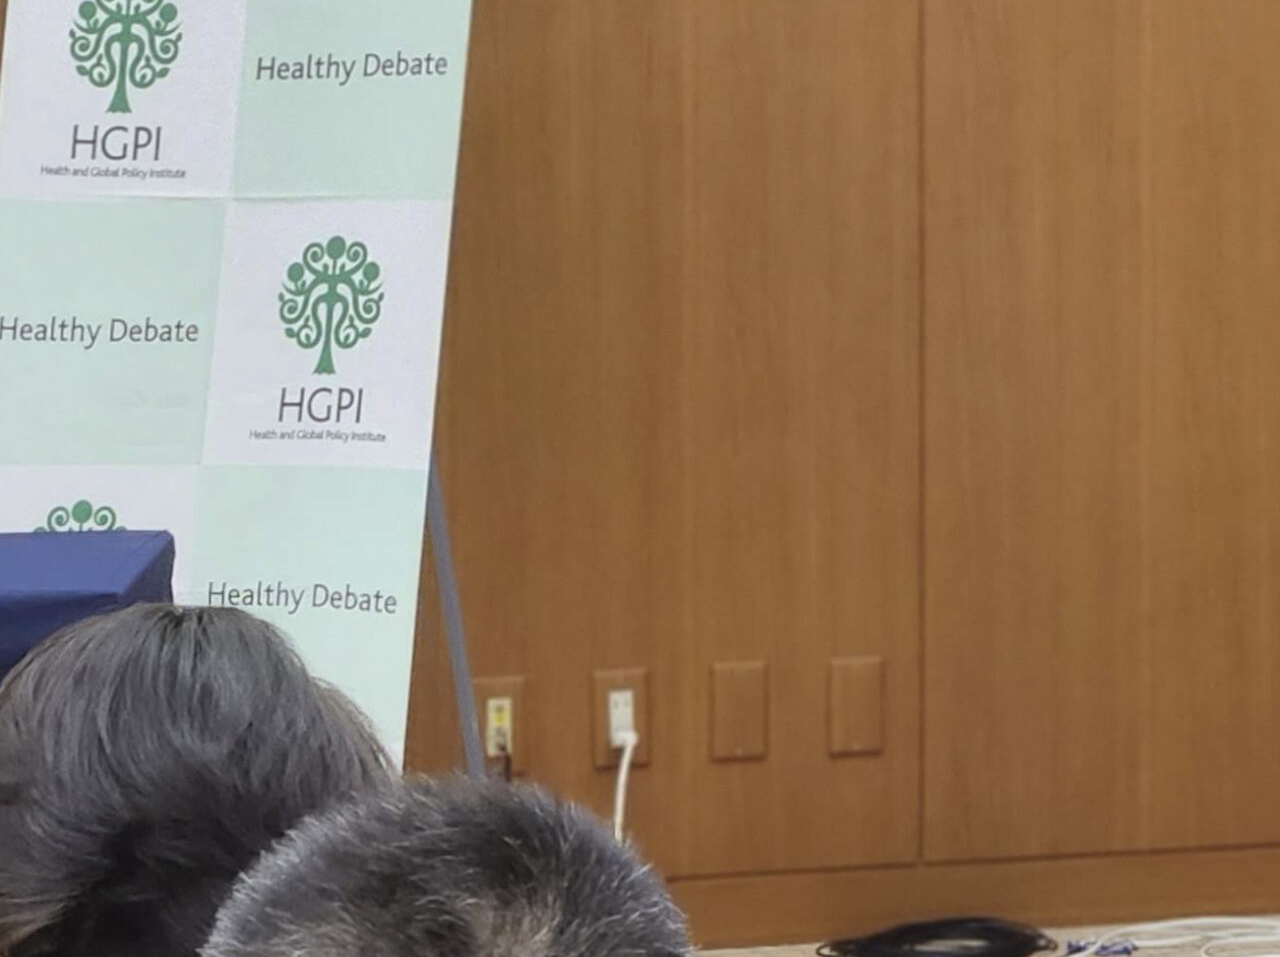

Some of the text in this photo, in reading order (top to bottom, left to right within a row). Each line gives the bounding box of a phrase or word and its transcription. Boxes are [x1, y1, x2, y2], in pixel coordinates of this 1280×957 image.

[256, 52, 448, 86] Healthy Debate
[70, 124, 161, 161] HGPI
[40, 165, 186, 181] Health and Global Policy Institute
[0, 316, 199, 350] Healthy Debate
[278, 387, 363, 423] HGPI
[249, 429, 386, 443] Health and Global Policy Institute
[208, 581, 397, 615] Healthy Debate
